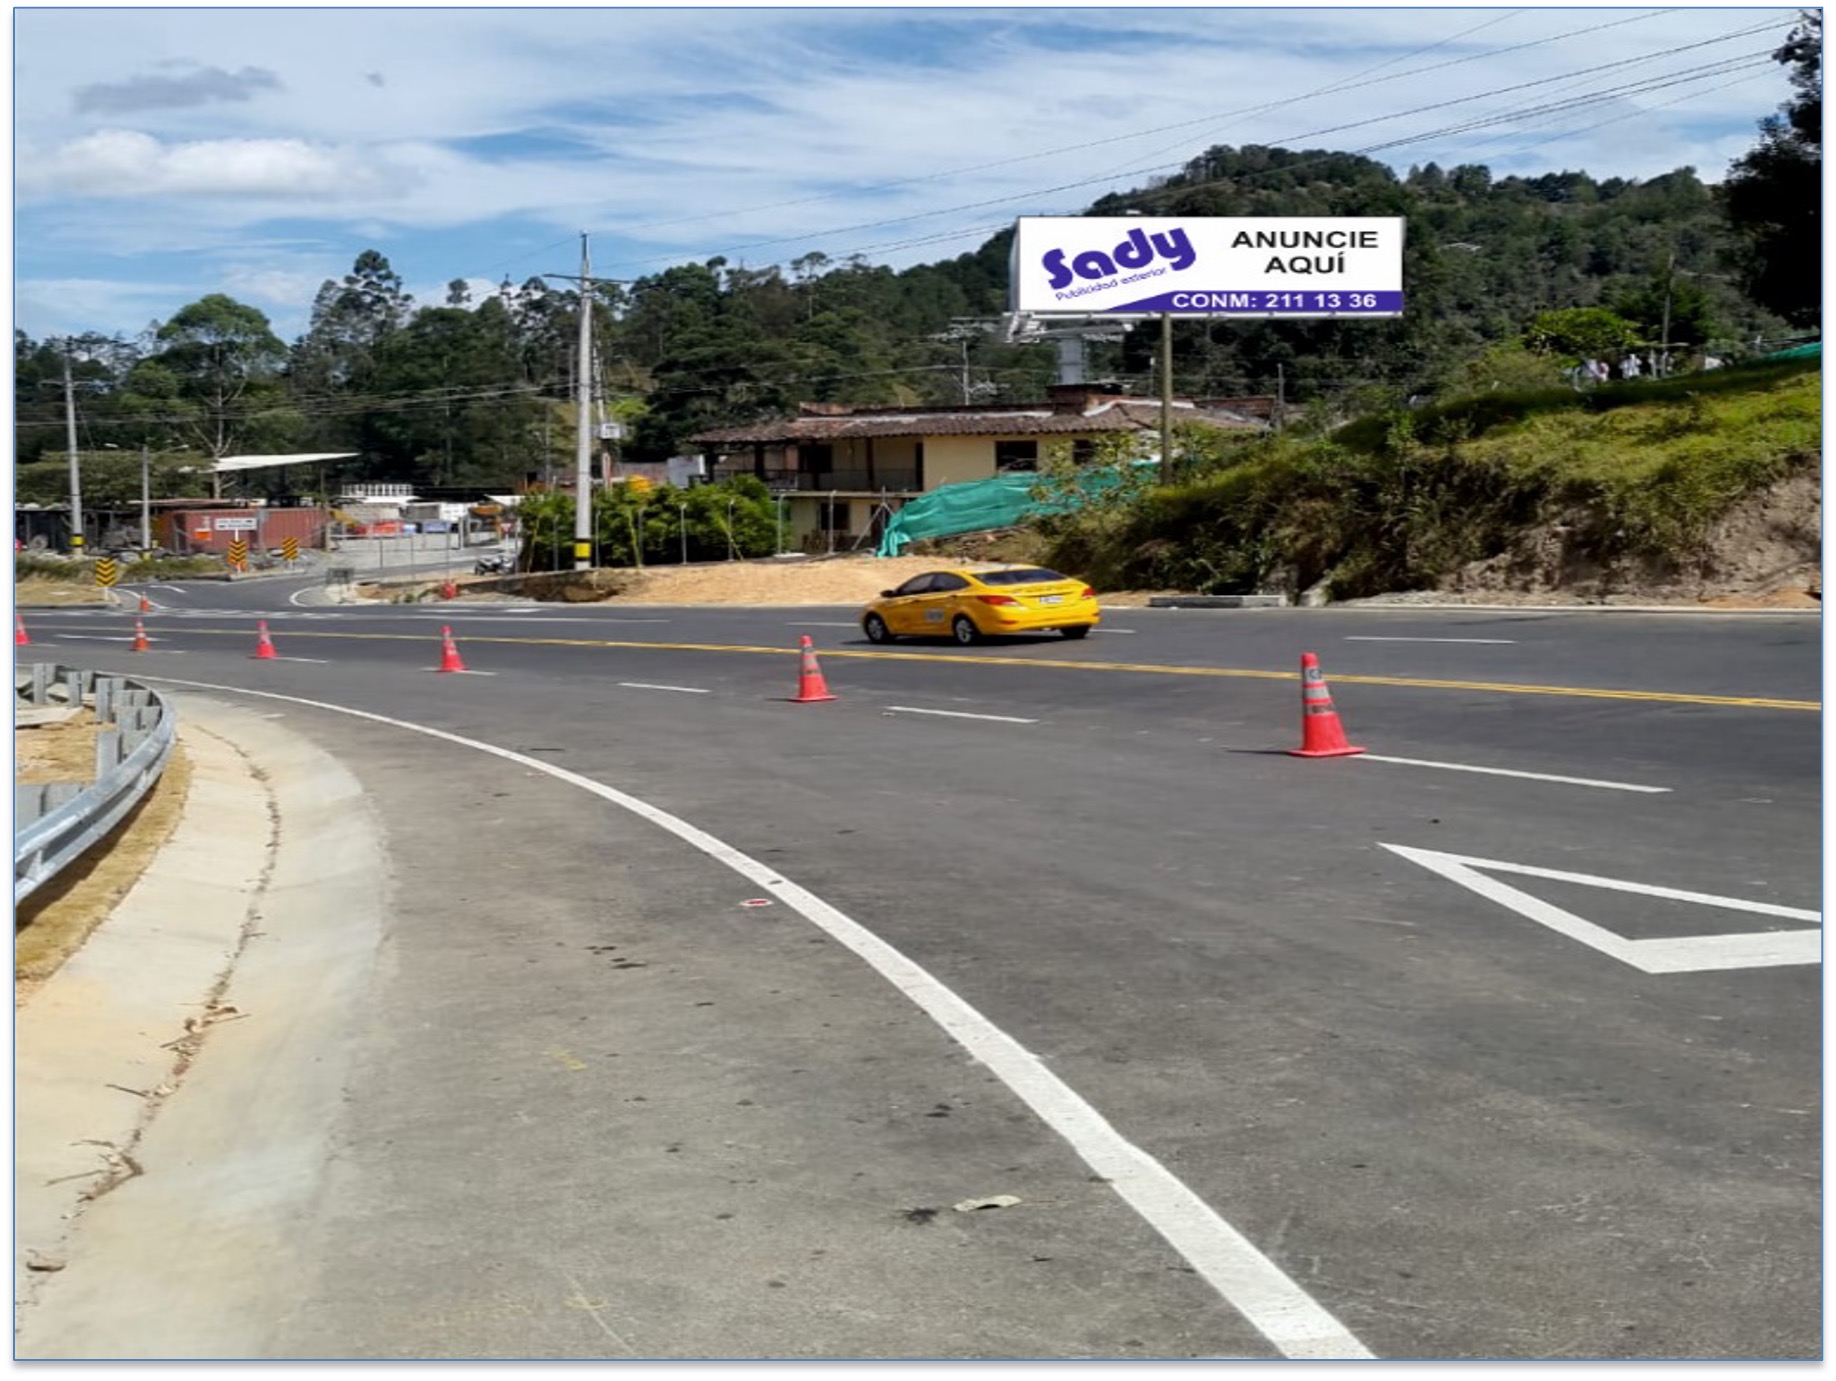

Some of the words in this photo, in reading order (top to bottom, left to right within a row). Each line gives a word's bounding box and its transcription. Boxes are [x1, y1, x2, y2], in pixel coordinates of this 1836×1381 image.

[1231, 230, 1378, 249] ANUNCIE
[1042, 227, 1196, 290] Sady
[1264, 251, 1344, 275] AQUÍ
[1055, 279, 1118, 301] Publicidad
[1120, 267, 1167, 284] exterior
[1172, 293, 1257, 308] CONM:
[1265, 293, 1303, 308] 211
[1314, 293, 1342, 308] 13
[1349, 293, 1377, 308] 36
